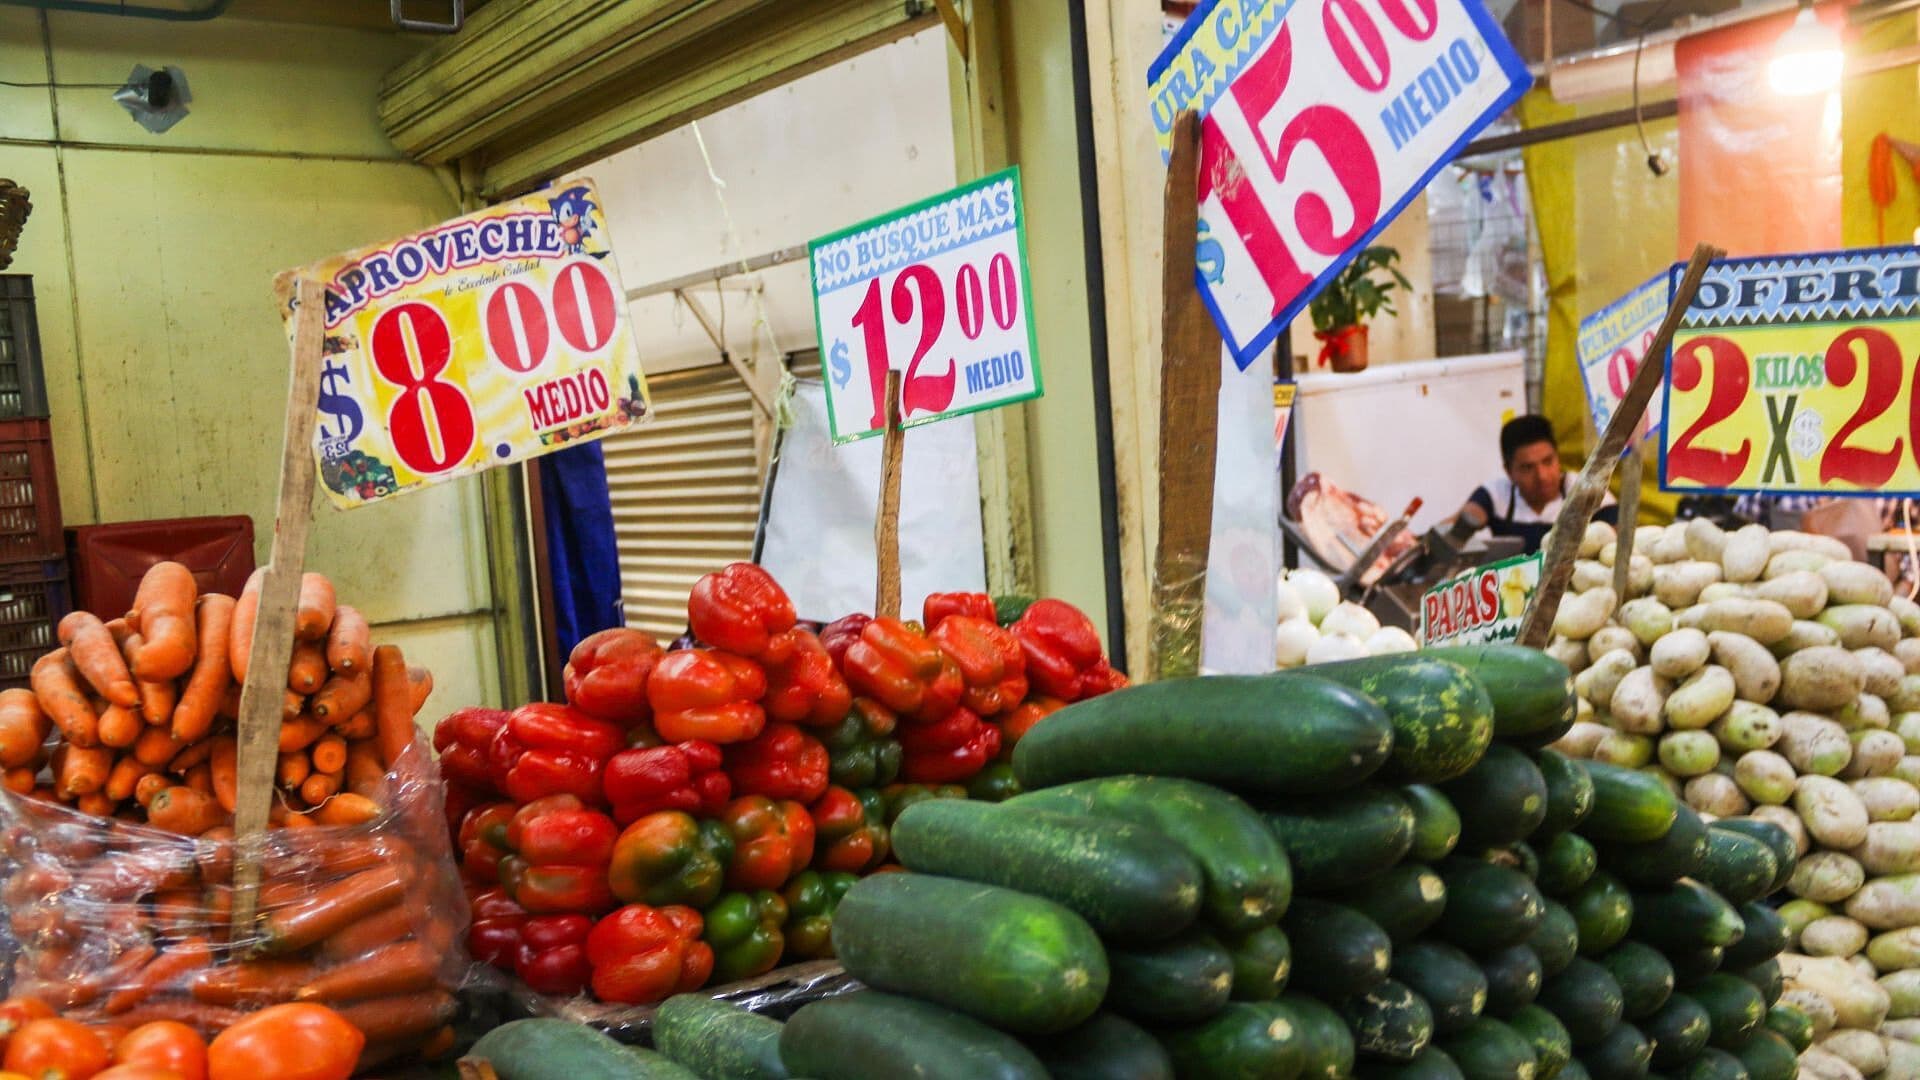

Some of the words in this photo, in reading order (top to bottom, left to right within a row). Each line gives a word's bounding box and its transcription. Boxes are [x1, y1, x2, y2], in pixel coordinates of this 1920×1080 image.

[1379, 37, 1480, 152] MEDIO
[1197, 19, 1381, 318] 15
[325, 218, 563, 324] APROVECHE
[819, 254, 851, 280] NO
[857, 211, 951, 268] BUSQUE
[957, 190, 1010, 227] MAS
[1689, 266, 1920, 312] OFERT
[525, 368, 609, 430] MEDIO
[829, 337, 852, 390] $
[851, 264, 956, 430] 12
[965, 350, 1024, 394] MEDIO
[1667, 335, 1750, 488] 2
[1754, 356, 1824, 387] KILOS
[1819, 326, 1920, 490] 2
[1426, 572, 1497, 640] PAPAS
